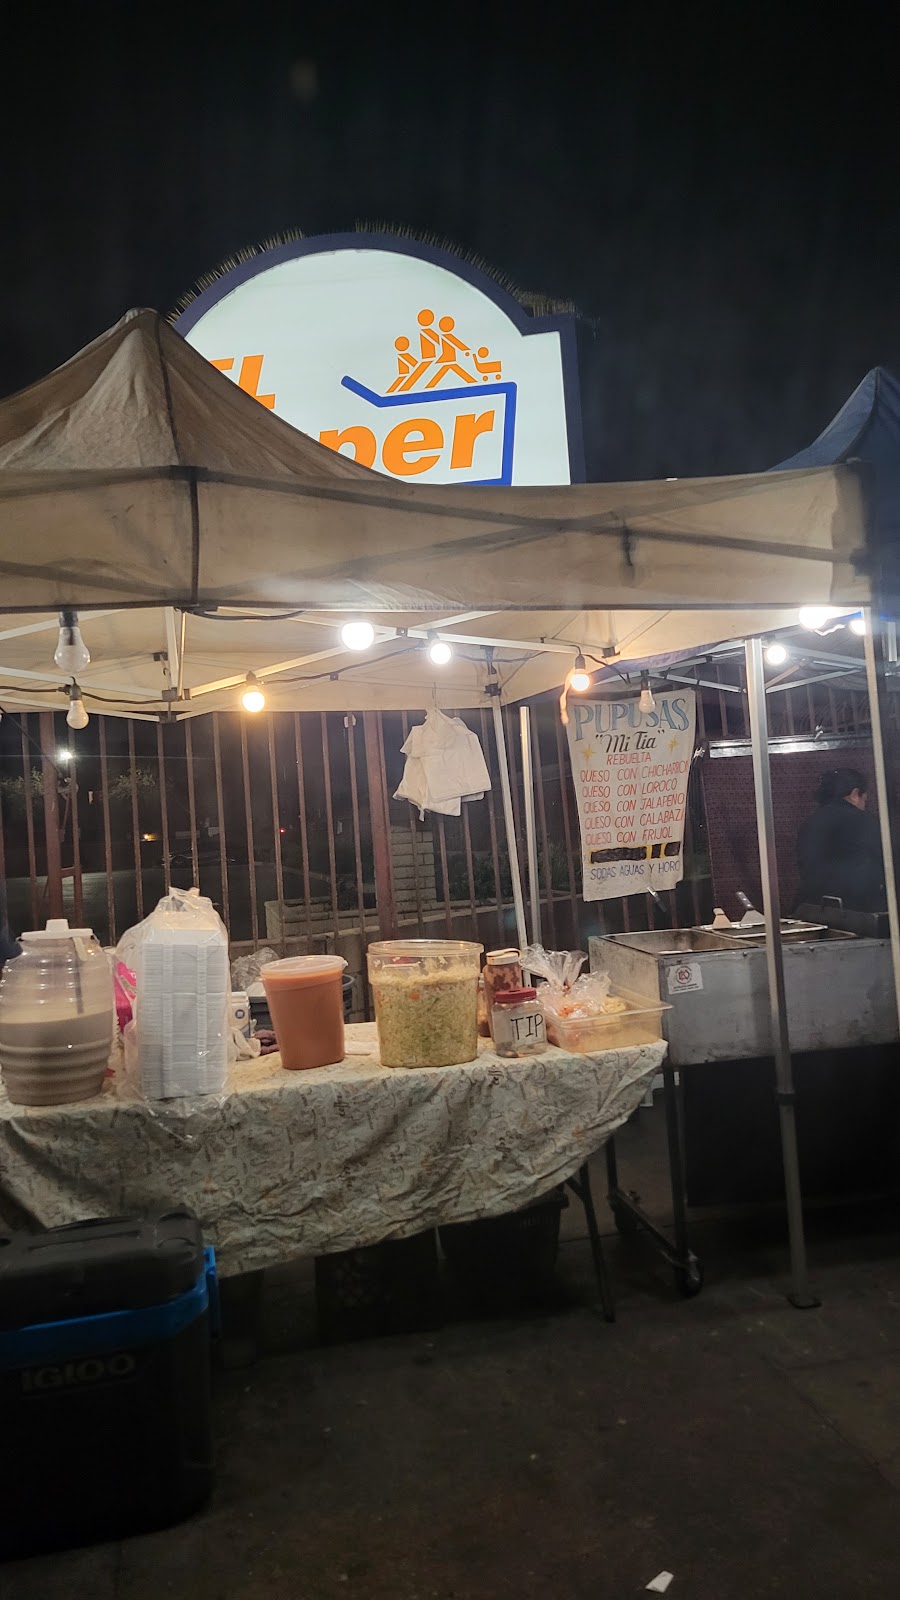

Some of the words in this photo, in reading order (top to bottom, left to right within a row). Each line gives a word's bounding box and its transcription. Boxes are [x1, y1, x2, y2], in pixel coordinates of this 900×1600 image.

[209, 355, 276, 410] L
[312, 410, 496, 476] per
[573, 698, 690, 741] PUPUSAS
[606, 752, 652, 765] REBUELTA
[580, 769, 610, 783] QUESO
[616, 767, 638, 780] CON
[582, 785, 611, 798] QUESO
[616, 783, 638, 796] CON
[641, 777, 678, 794] LOROCO
[583, 801, 611, 814] QUESO
[616, 799, 637, 812] CON
[584, 815, 611, 830] QUESO
[614, 815, 635, 828] CON
[585, 831, 612, 846] QUESO
[616, 830, 637, 843] CON
[641, 826, 673, 841] FRIJOL
[590, 866, 616, 880] SODAS
[619, 864, 645, 876] AGUAS
[648, 863, 656, 874] Y
[510, 1013, 544, 1041] TIP
[20, 1353, 135, 1393] IGLOO
